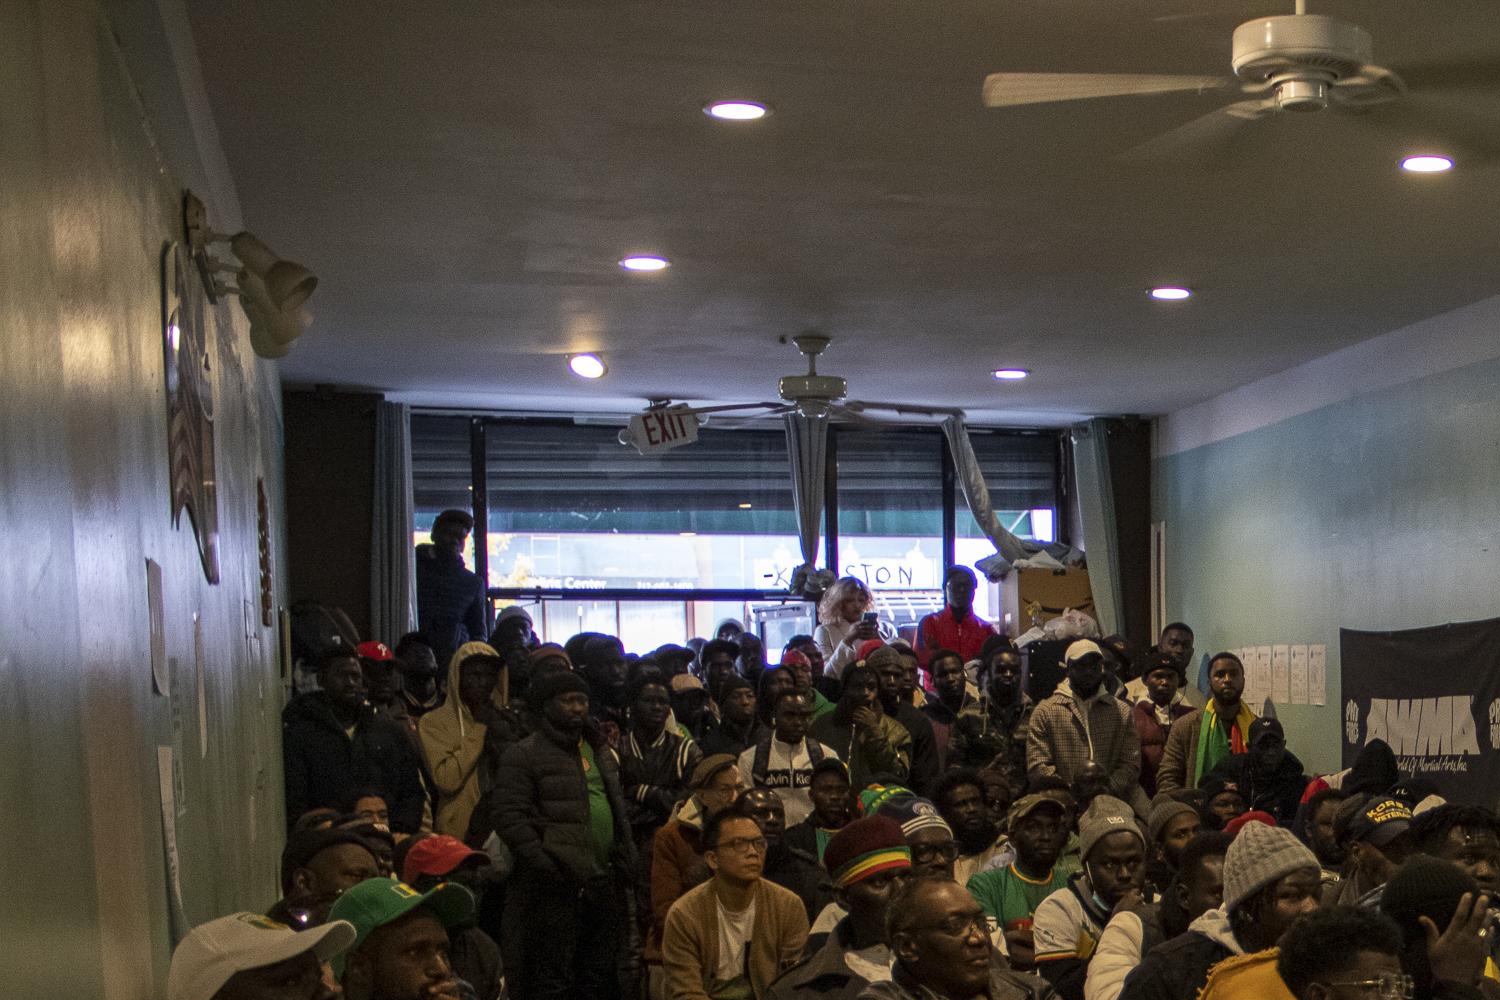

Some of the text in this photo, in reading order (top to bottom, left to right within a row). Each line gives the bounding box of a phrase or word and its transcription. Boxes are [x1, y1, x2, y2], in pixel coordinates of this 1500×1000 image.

[642, 411, 689, 446] EXIT
[1364, 695, 1481, 756] AWMA
[1417, 756, 1442, 773] Martial
[764, 772, 810, 786] alvin Kle
